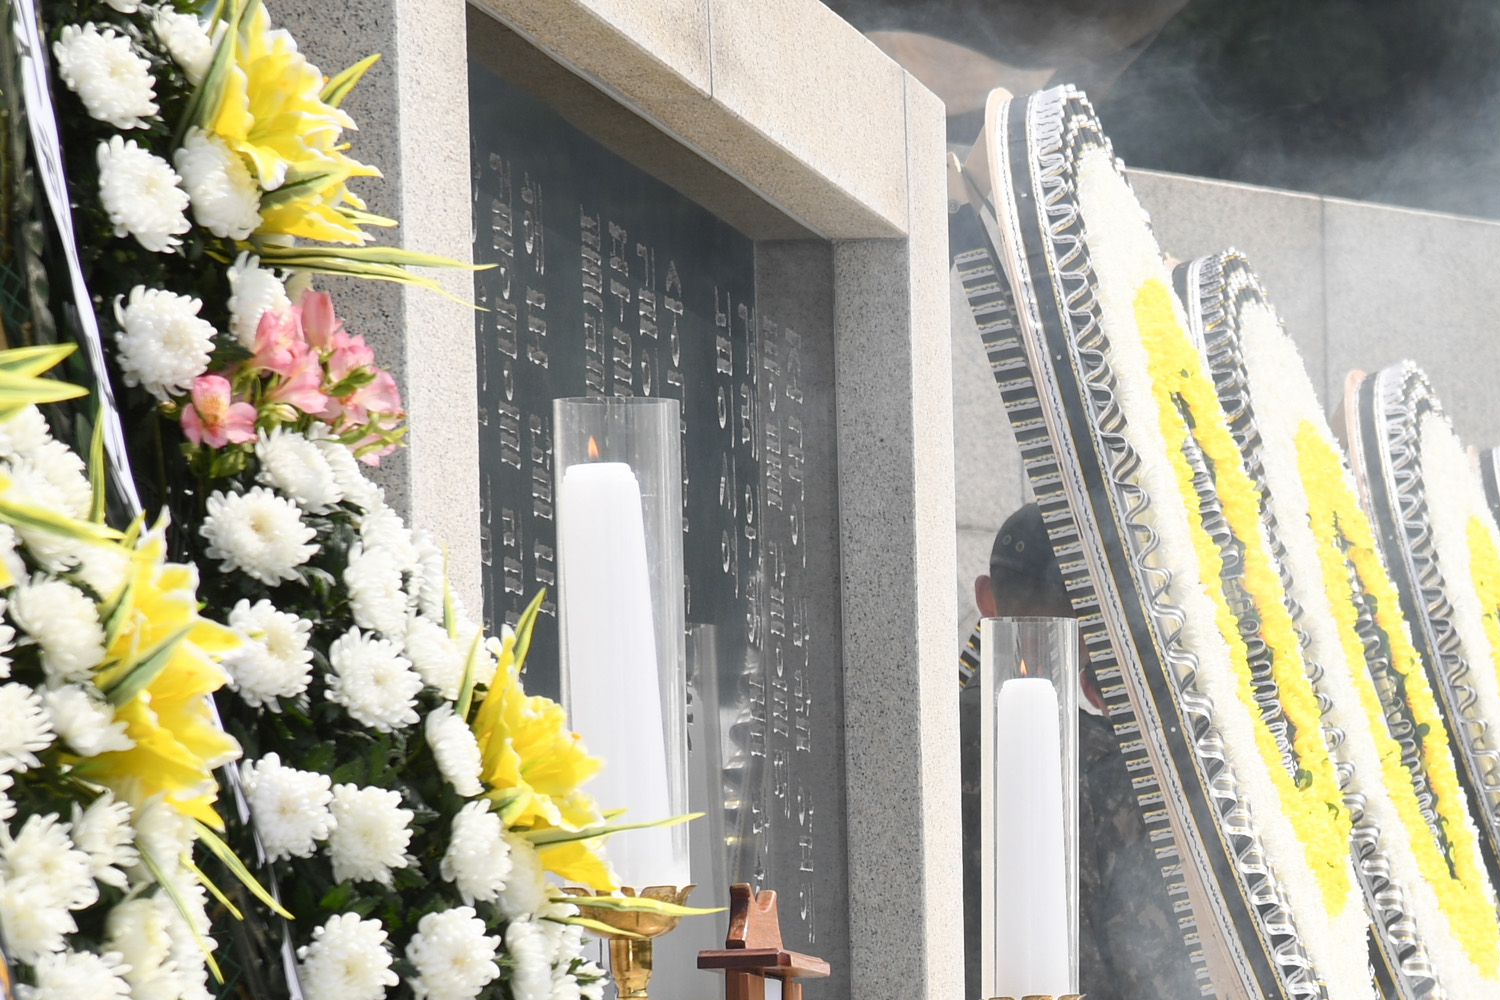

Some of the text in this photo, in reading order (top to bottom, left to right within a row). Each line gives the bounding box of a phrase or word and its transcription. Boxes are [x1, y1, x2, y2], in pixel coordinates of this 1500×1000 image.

[714, 284, 739, 599] 님이시여
[738, 300, 760, 462] 겨레
[784, 325, 807, 570] 조국이
